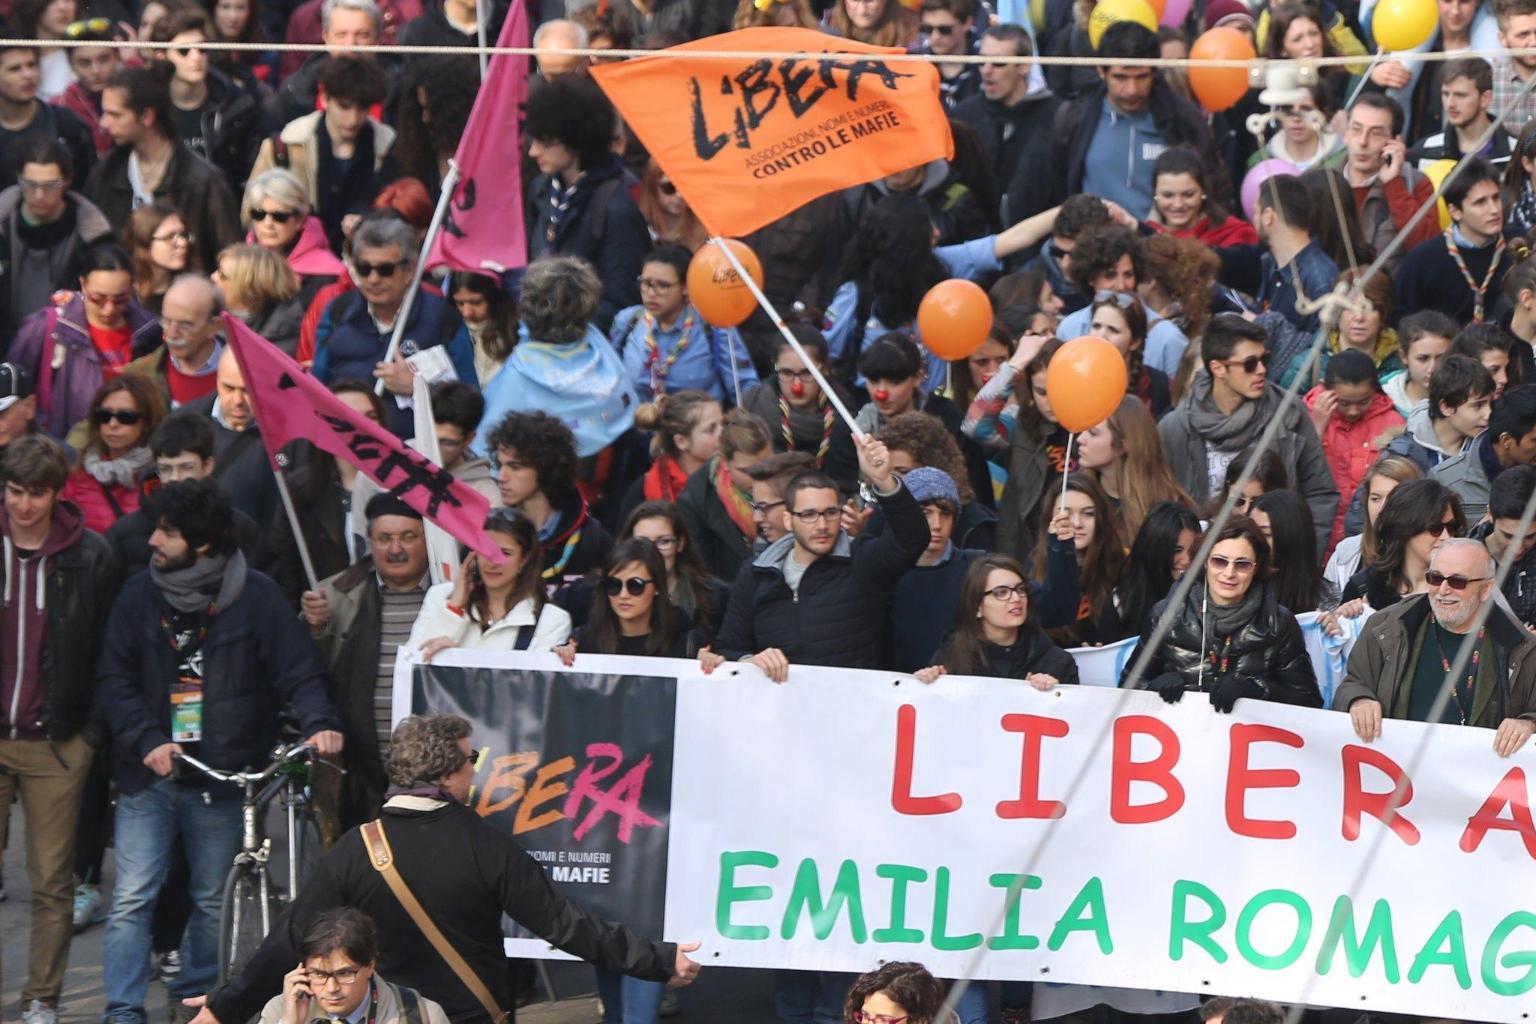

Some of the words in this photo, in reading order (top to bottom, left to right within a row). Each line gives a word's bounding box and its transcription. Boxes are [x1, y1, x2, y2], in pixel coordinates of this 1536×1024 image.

[752, 139, 828, 179] CONTRO
[825, 128, 853, 150] LE
[850, 110, 900, 140] MAFIE
[551, 866, 611, 885] MAFIE
[567, 851, 612, 865] NUMERI
[715, 849, 1114, 955] EMILIA
